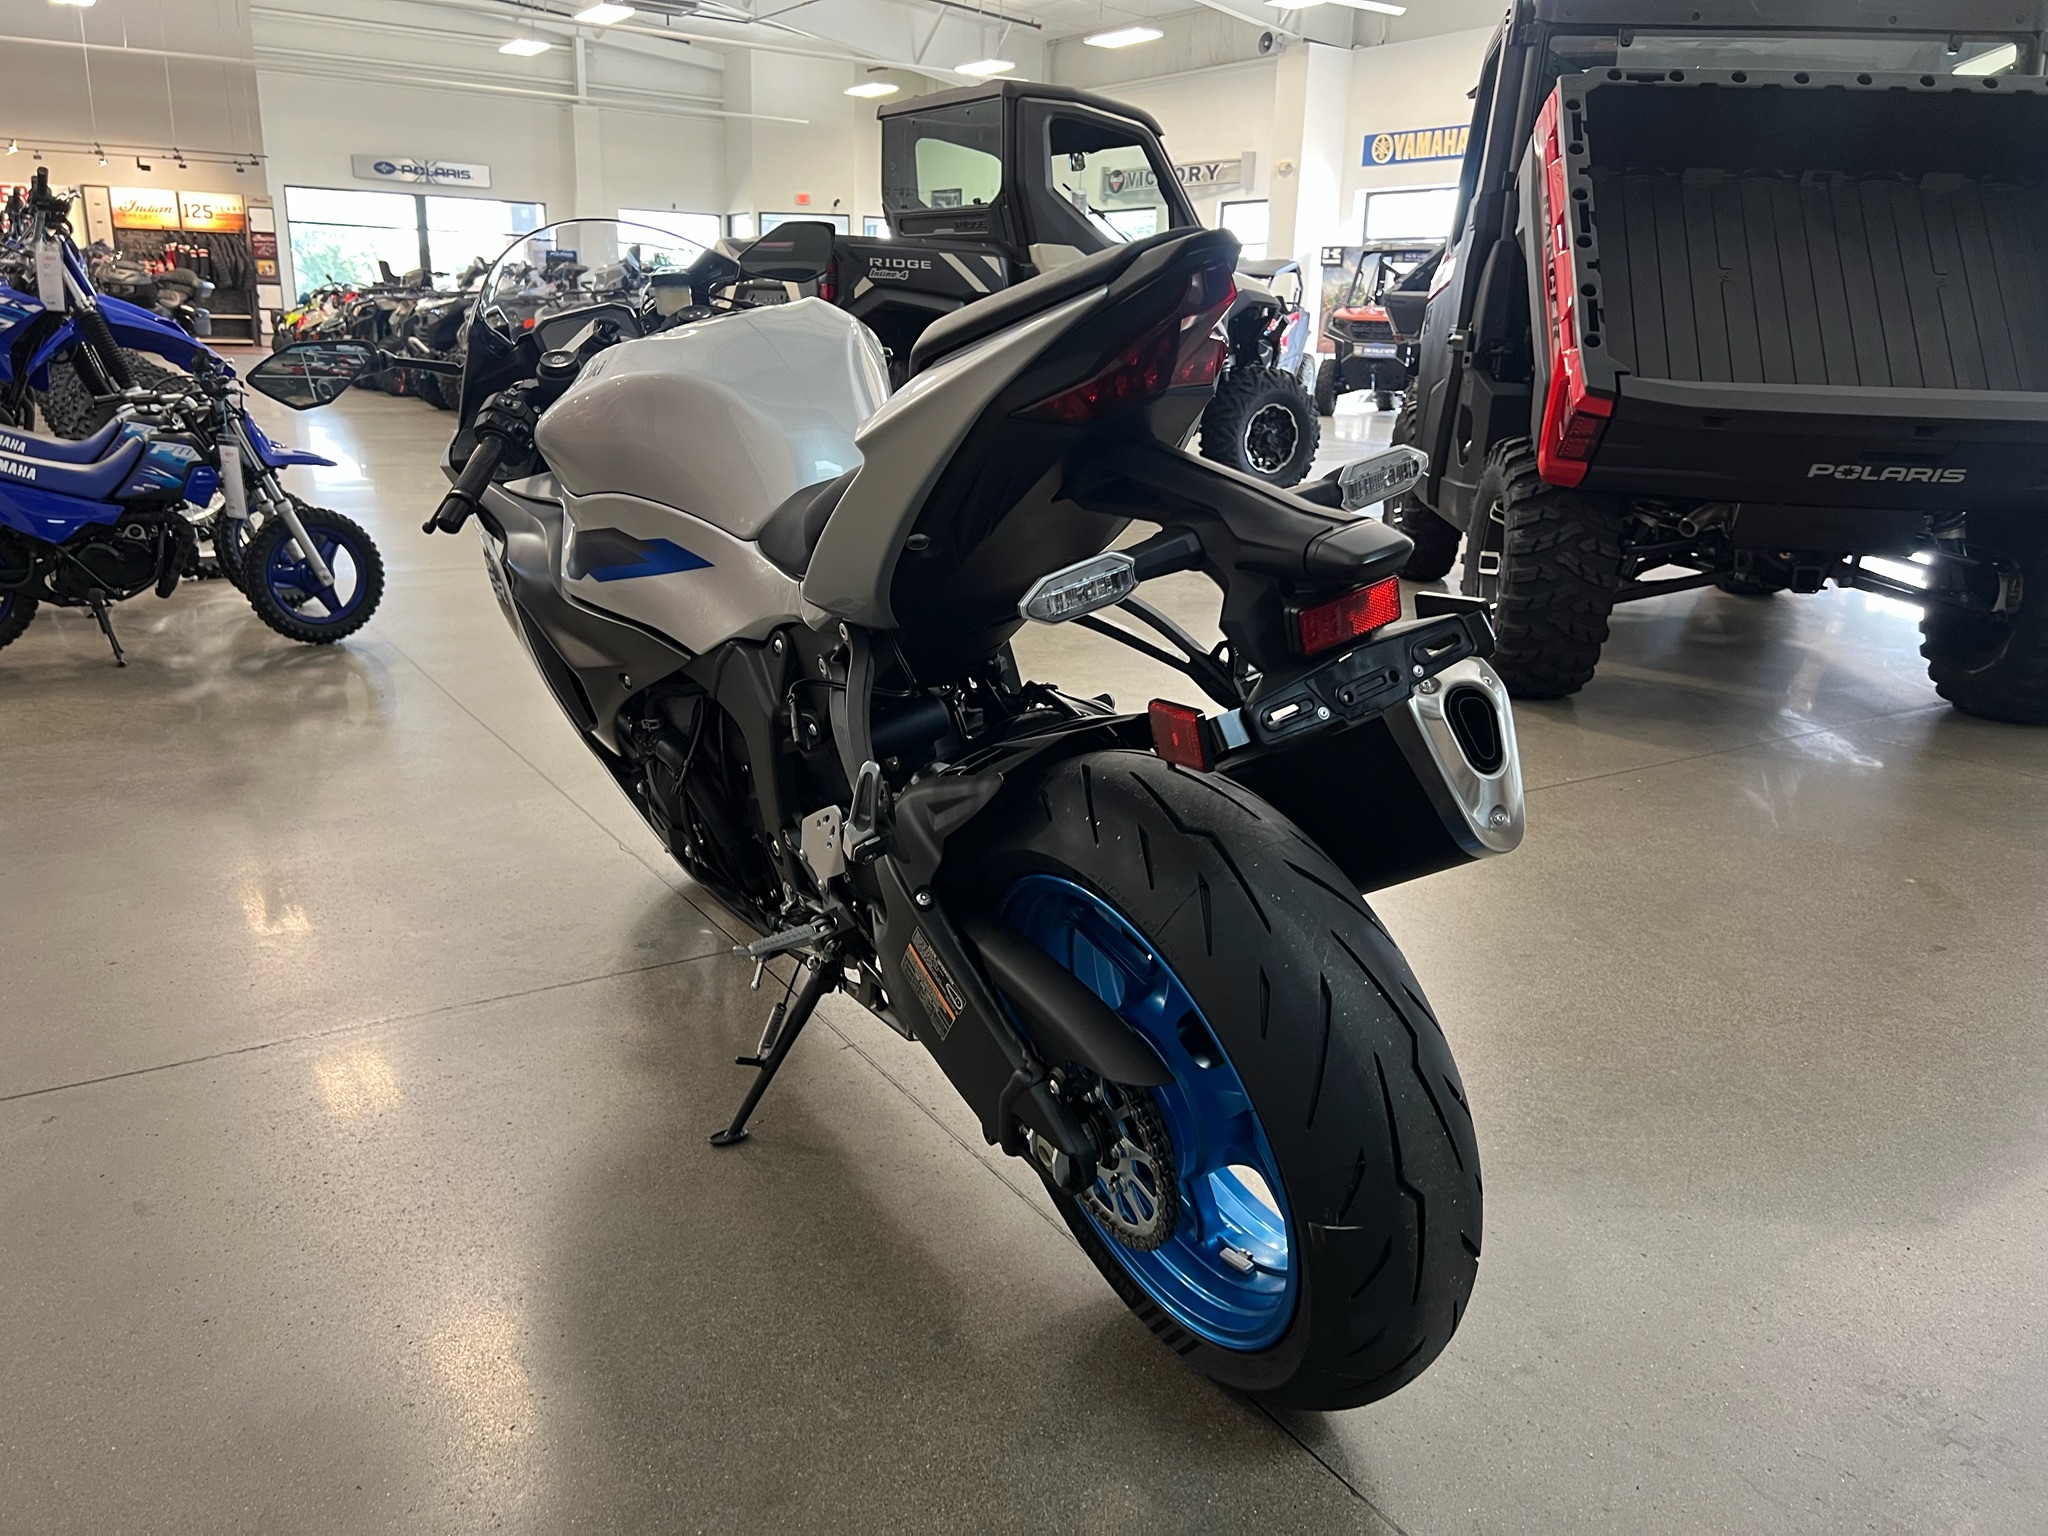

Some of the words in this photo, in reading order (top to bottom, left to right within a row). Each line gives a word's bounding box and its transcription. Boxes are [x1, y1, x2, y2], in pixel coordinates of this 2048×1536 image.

[1394, 127, 1470, 161] YAMAHA
[401, 164, 472, 180] POLARIS
[119, 199, 173, 214] Indian
[183, 203, 213, 219] 125
[868, 257, 932, 270] RIDGE
[869, 268, 898, 279] Inline
[1807, 463, 1967, 483] POLARIS
